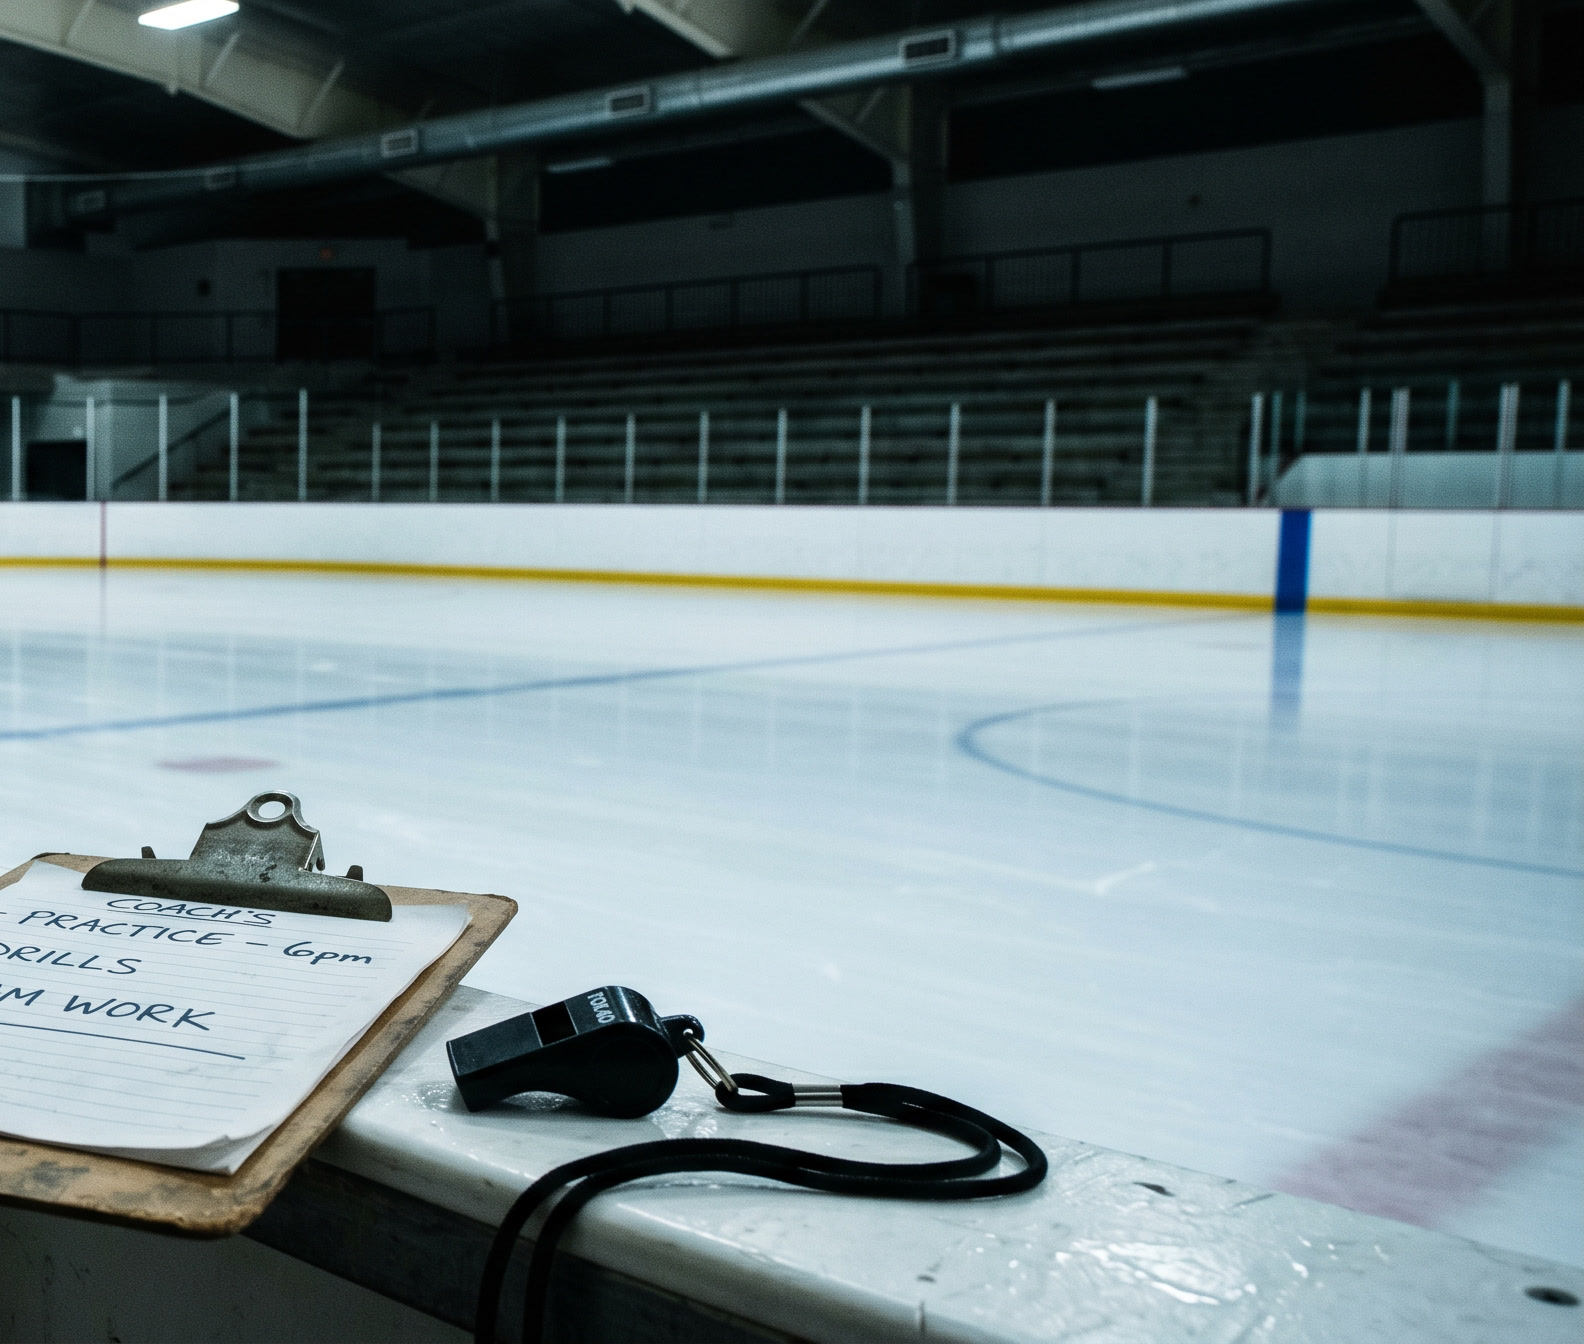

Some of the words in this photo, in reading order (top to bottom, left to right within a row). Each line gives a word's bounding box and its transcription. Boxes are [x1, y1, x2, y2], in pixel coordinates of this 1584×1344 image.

[106, 898, 277, 926] COACH'S
[18, 910, 235, 946] PRACTICE
[283, 940, 373, 967] 6pm
[63, 995, 216, 1032] WORK
